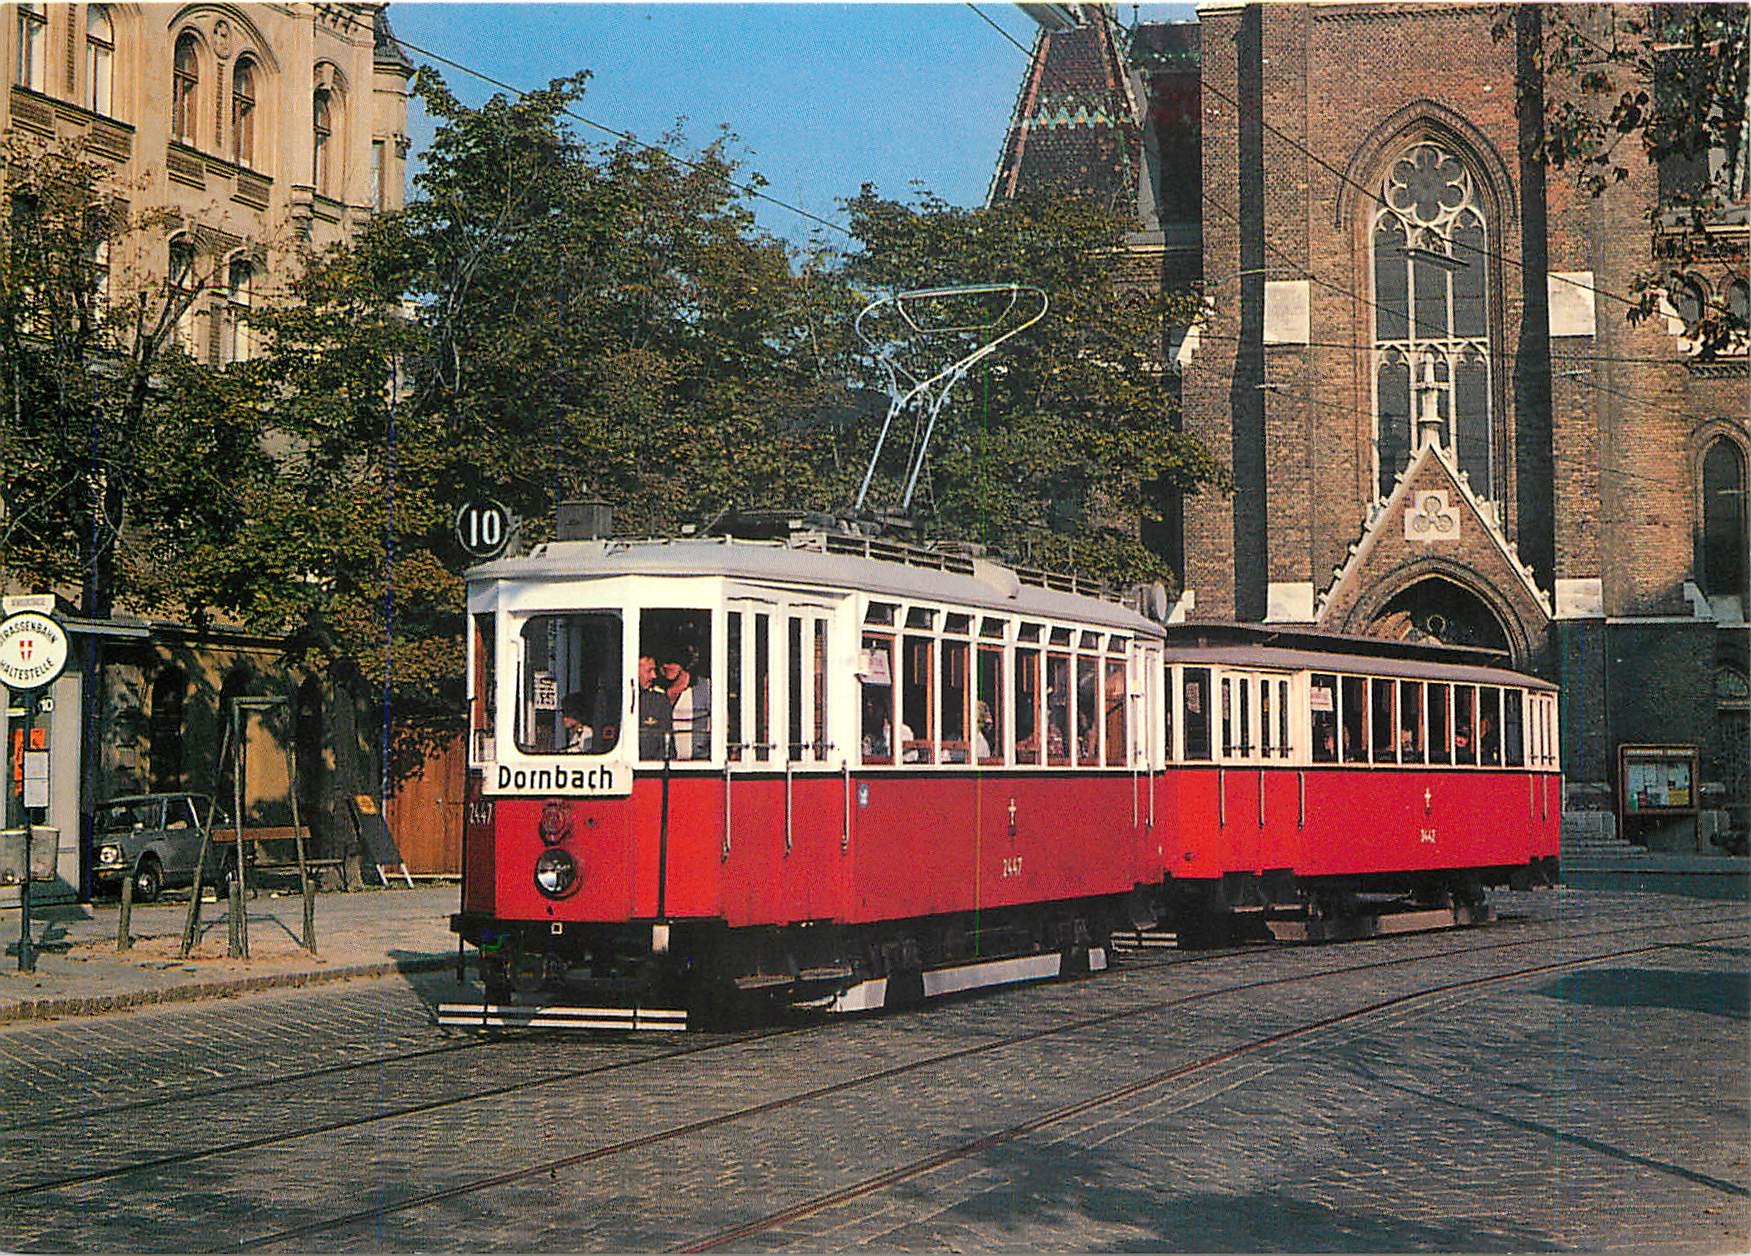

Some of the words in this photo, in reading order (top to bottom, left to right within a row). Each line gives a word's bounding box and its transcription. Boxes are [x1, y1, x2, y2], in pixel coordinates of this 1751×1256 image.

[470, 509, 500, 546] 10
[0, 657, 55, 680] HALTESTELLE
[498, 764, 613, 789] Dornbach
[468, 801, 494, 824] 2447
[1002, 857, 1023, 877] 2447
